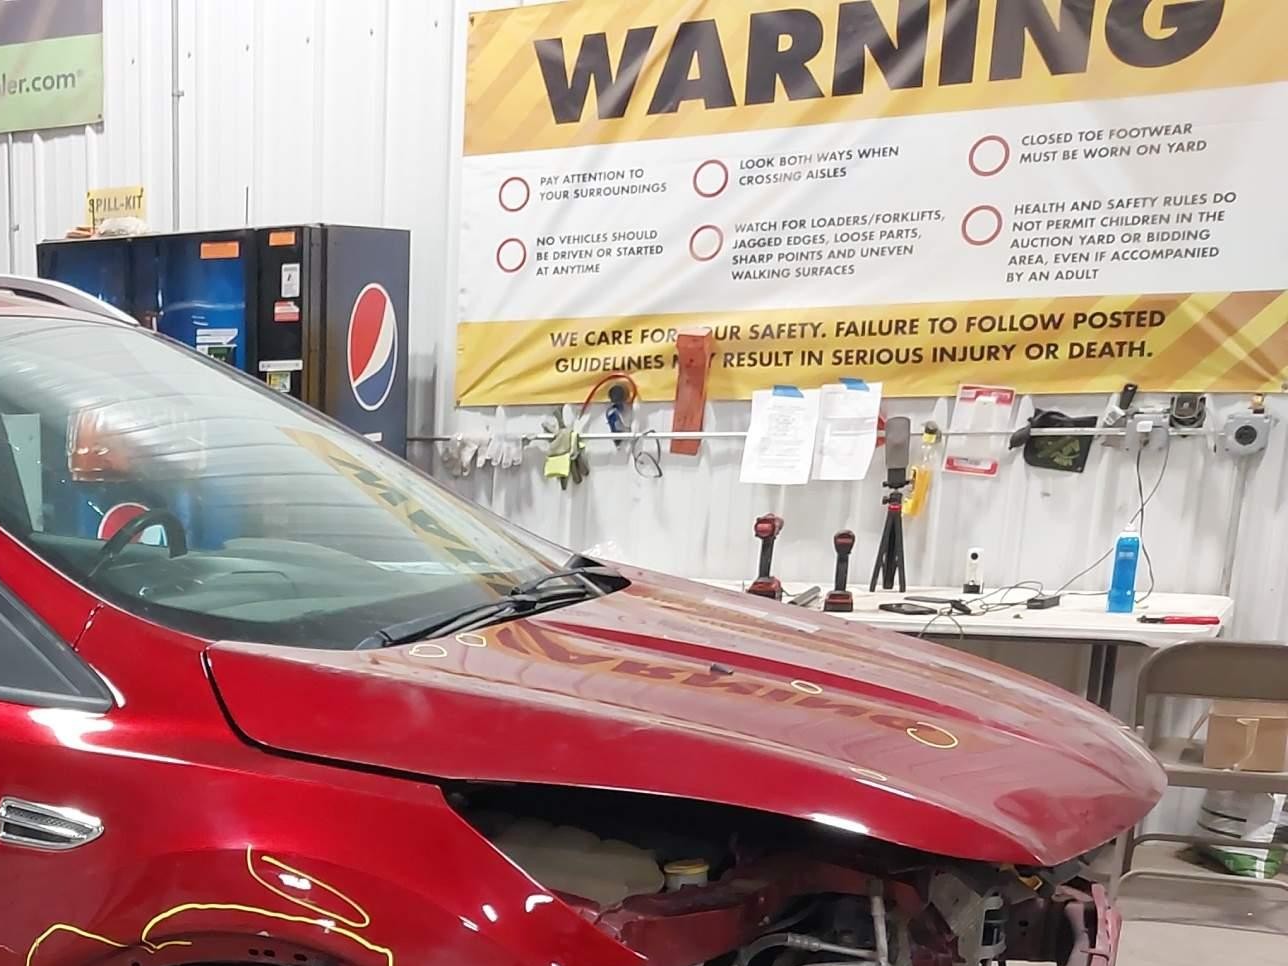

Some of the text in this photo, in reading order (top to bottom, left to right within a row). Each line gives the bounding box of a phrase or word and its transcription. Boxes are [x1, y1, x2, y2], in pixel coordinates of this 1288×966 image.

[534, 0, 1225, 125] WARNING
[1021, 123, 1193, 146] CLOSED TOE FOOTWEAR
[740, 146, 899, 170] LOOK BOTH WAYS WHEN
[1019, 140, 1207, 164] MUST BE WORN ON YARD
[540, 168, 644, 186] PAY ATTENTION TO
[739, 167, 847, 186] CROSSING AISLES
[539, 182, 667, 201] YOUR SURROUNDINGS
[88, 195, 142, 213] SPILL-KIT
[1014, 191, 1237, 215] HEALTH AND SAFETY RULES DO
[734, 209, 946, 233] WATCH FOR LOADERS/FORKLIFTS,
[1012, 210, 1225, 232] NOT PERMIT CHILDREN IN THE
[536, 230, 658, 246] NO VEHICLES SHOULD
[732, 228, 922, 250] JAGGED EDGES, LOOSE PARTS,
[1010, 229, 1211, 249] AUCTION YARD OR BIDDING
[536, 245, 663, 261] BE DRIVEN OR STARTED
[732, 245, 914, 265] SHARP POINTS AND UNEVEN
[1008, 246, 1220, 267] AREA, EVEN IF ACCOMPANIED
[536, 264, 600, 276] AT ANYTIME
[731, 264, 855, 281] WALKING SURFACES
[1006, 268, 1099, 283] BY AN ADULT
[550, 331, 578, 347] WE
[584, 329, 633, 345] CARE
[640, 327, 677, 344] FOR
[749, 322, 826, 341] SAFETY.
[835, 318, 920, 337] FAILURE
[928, 316, 957, 334] TO
[966, 313, 1065, 333] FOLLOW
[1073, 310, 1166, 330] POSTED
[555, 354, 663, 373] GUIDELINES
[723, 351, 793, 368] RESULT
[800, 350, 823, 366] IN
[831, 347, 923, 365] SERIOUS
[931, 344, 1016, 363] INJURY
[1025, 342, 1059, 360] OR
[1068, 340, 1153, 359] DEATH.
